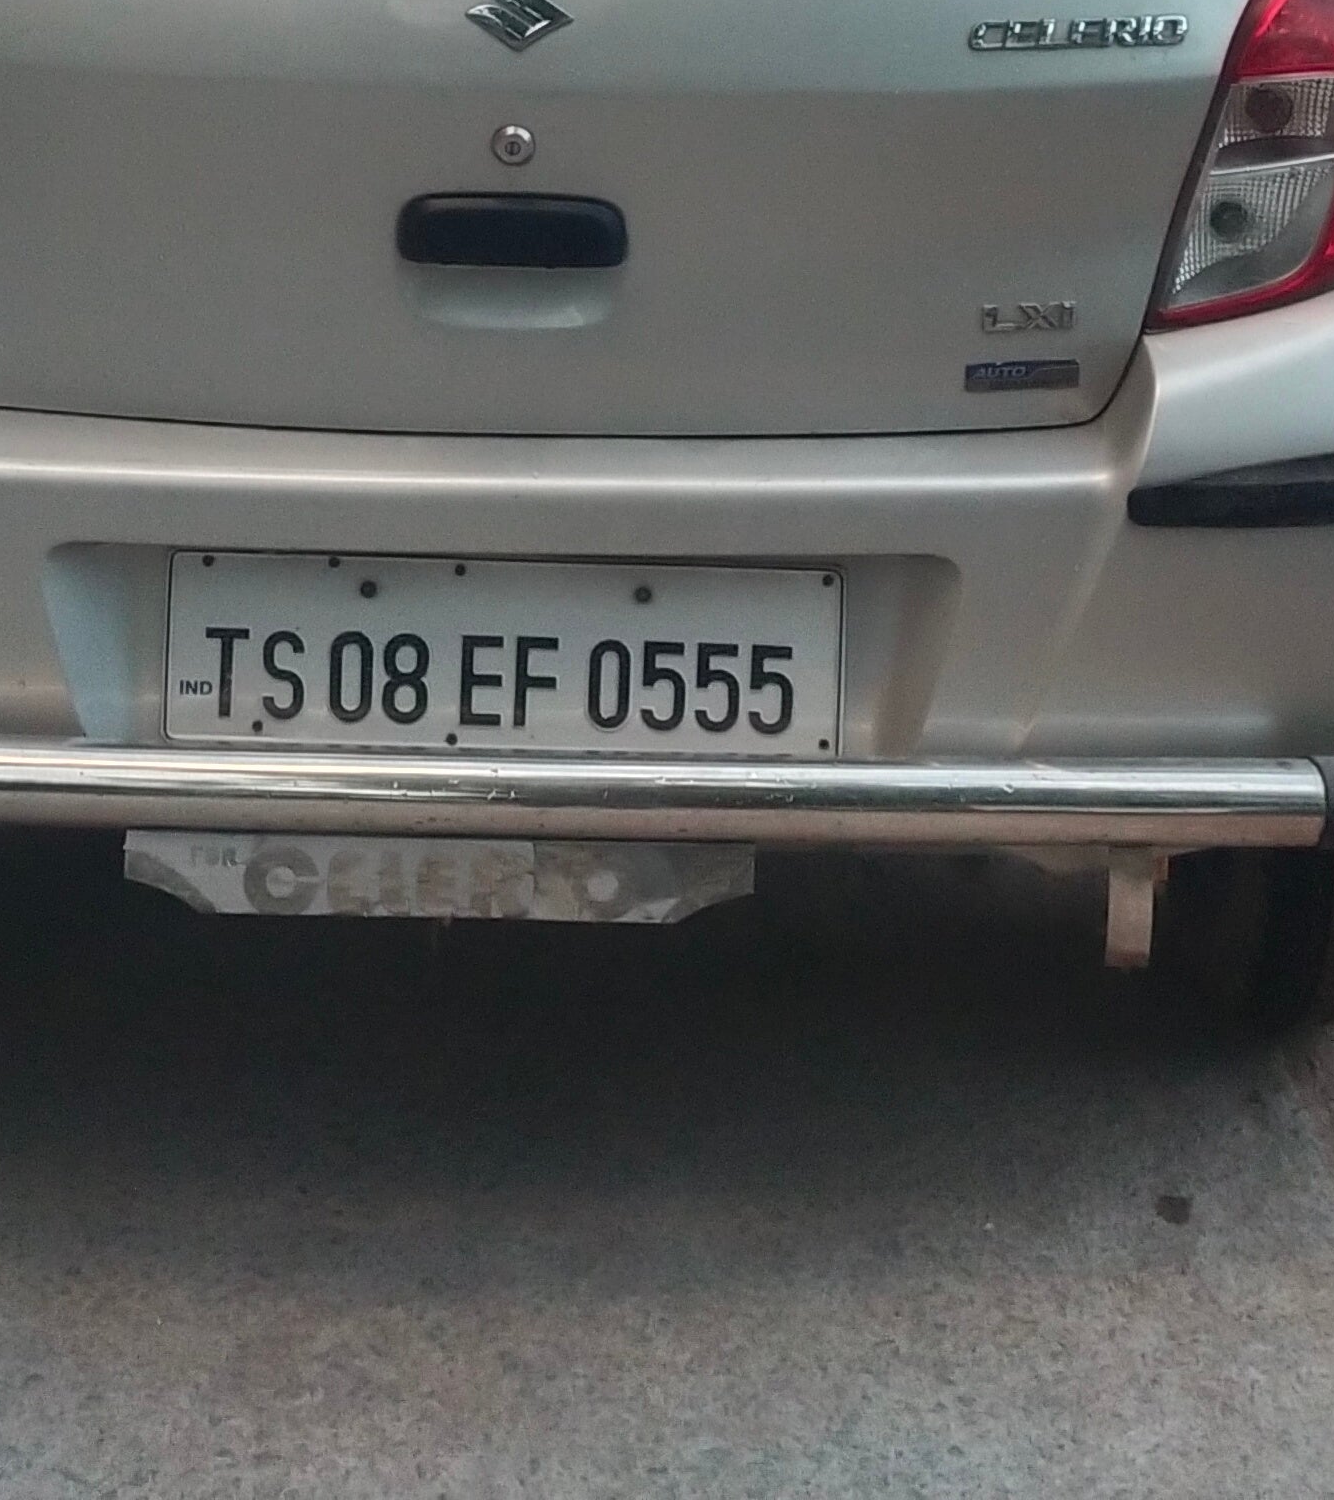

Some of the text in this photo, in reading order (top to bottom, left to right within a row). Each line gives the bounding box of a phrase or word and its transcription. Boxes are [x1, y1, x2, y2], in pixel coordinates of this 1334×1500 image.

[969, 13, 1188, 50] CELERIO
[179, 679, 213, 695] IND
[205, 627, 794, 735] TS 08 EF 0555
